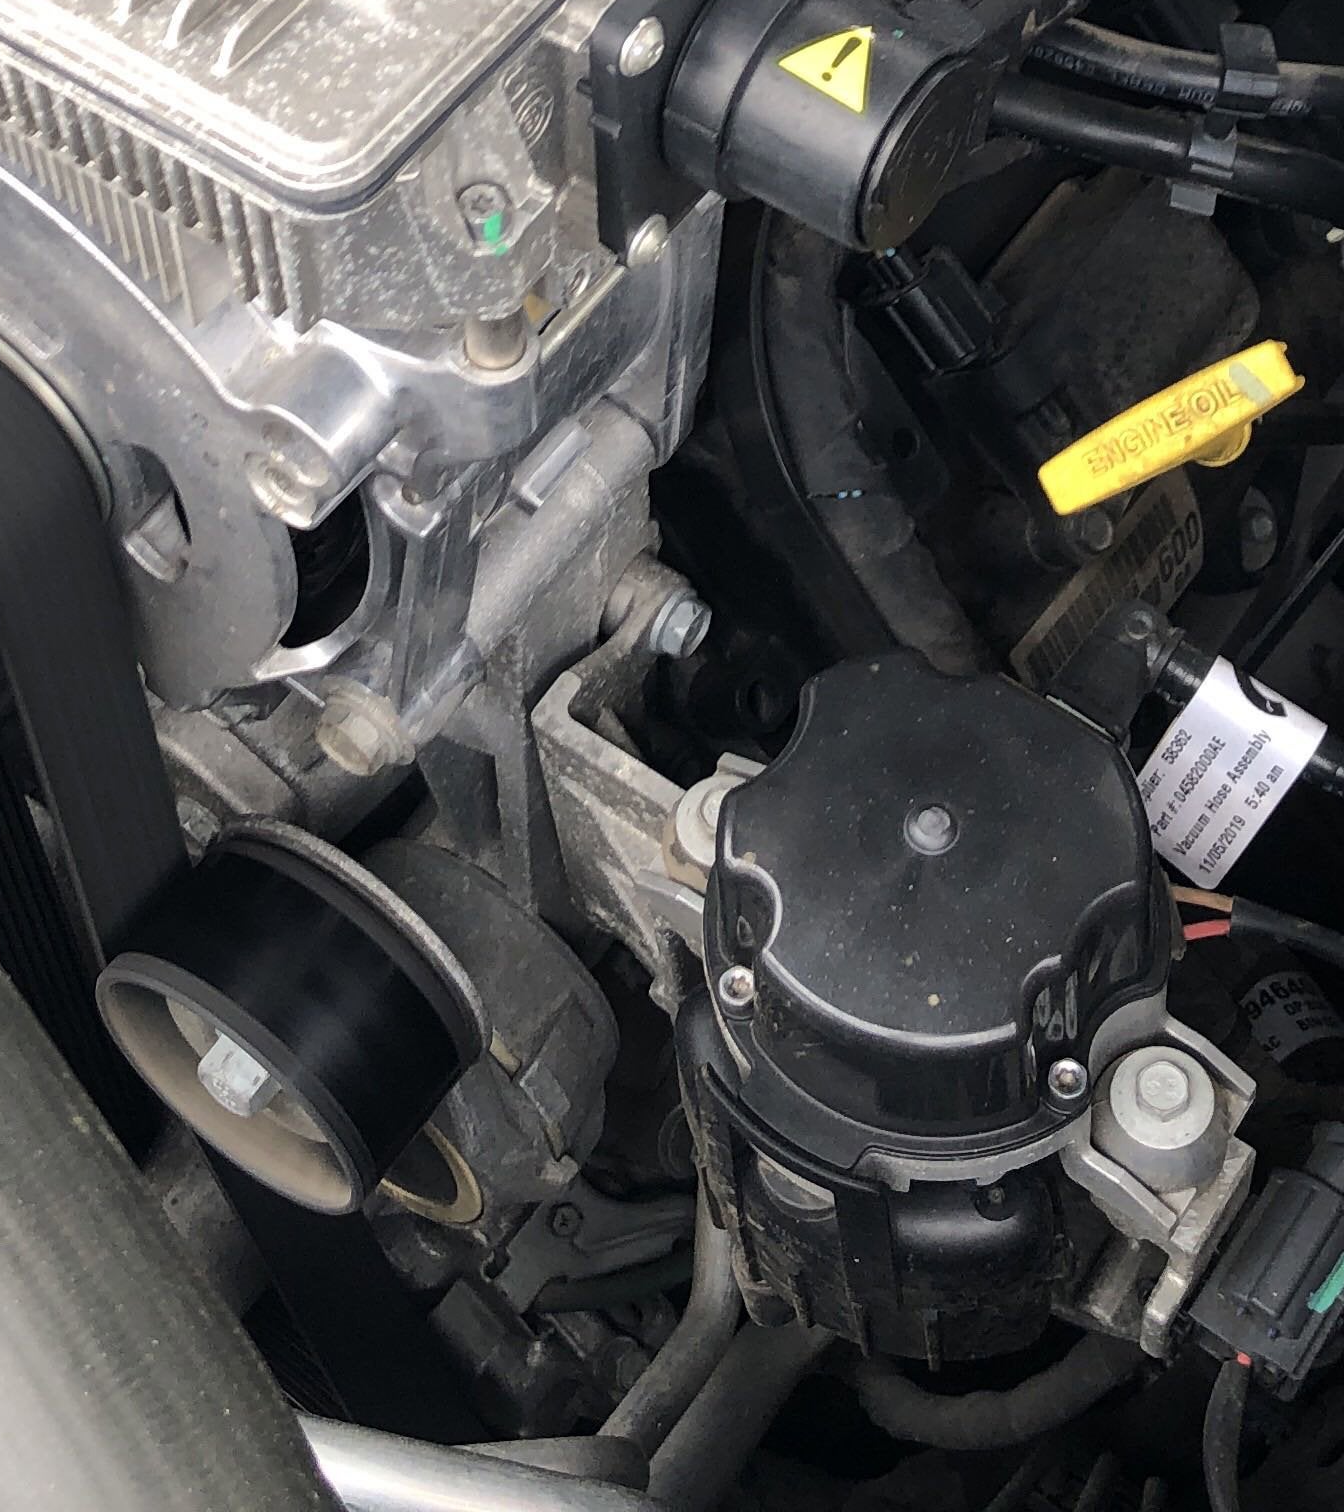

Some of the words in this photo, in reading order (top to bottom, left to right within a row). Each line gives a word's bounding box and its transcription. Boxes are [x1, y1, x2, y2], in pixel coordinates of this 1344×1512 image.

[1081, 406, 1193, 480] ENGINE
[1188, 378, 1243, 420] OIL
[1151, 807, 1174, 838] Part
[1172, 811, 1212, 858] Vacuum
[1204, 780, 1233, 816] Hose
[1225, 728, 1273, 785] Assembly
[1198, 814, 1247, 875] 11/05/2019
[1244, 781, 1272, 811] 5:40
[1266, 763, 1286, 785] am
